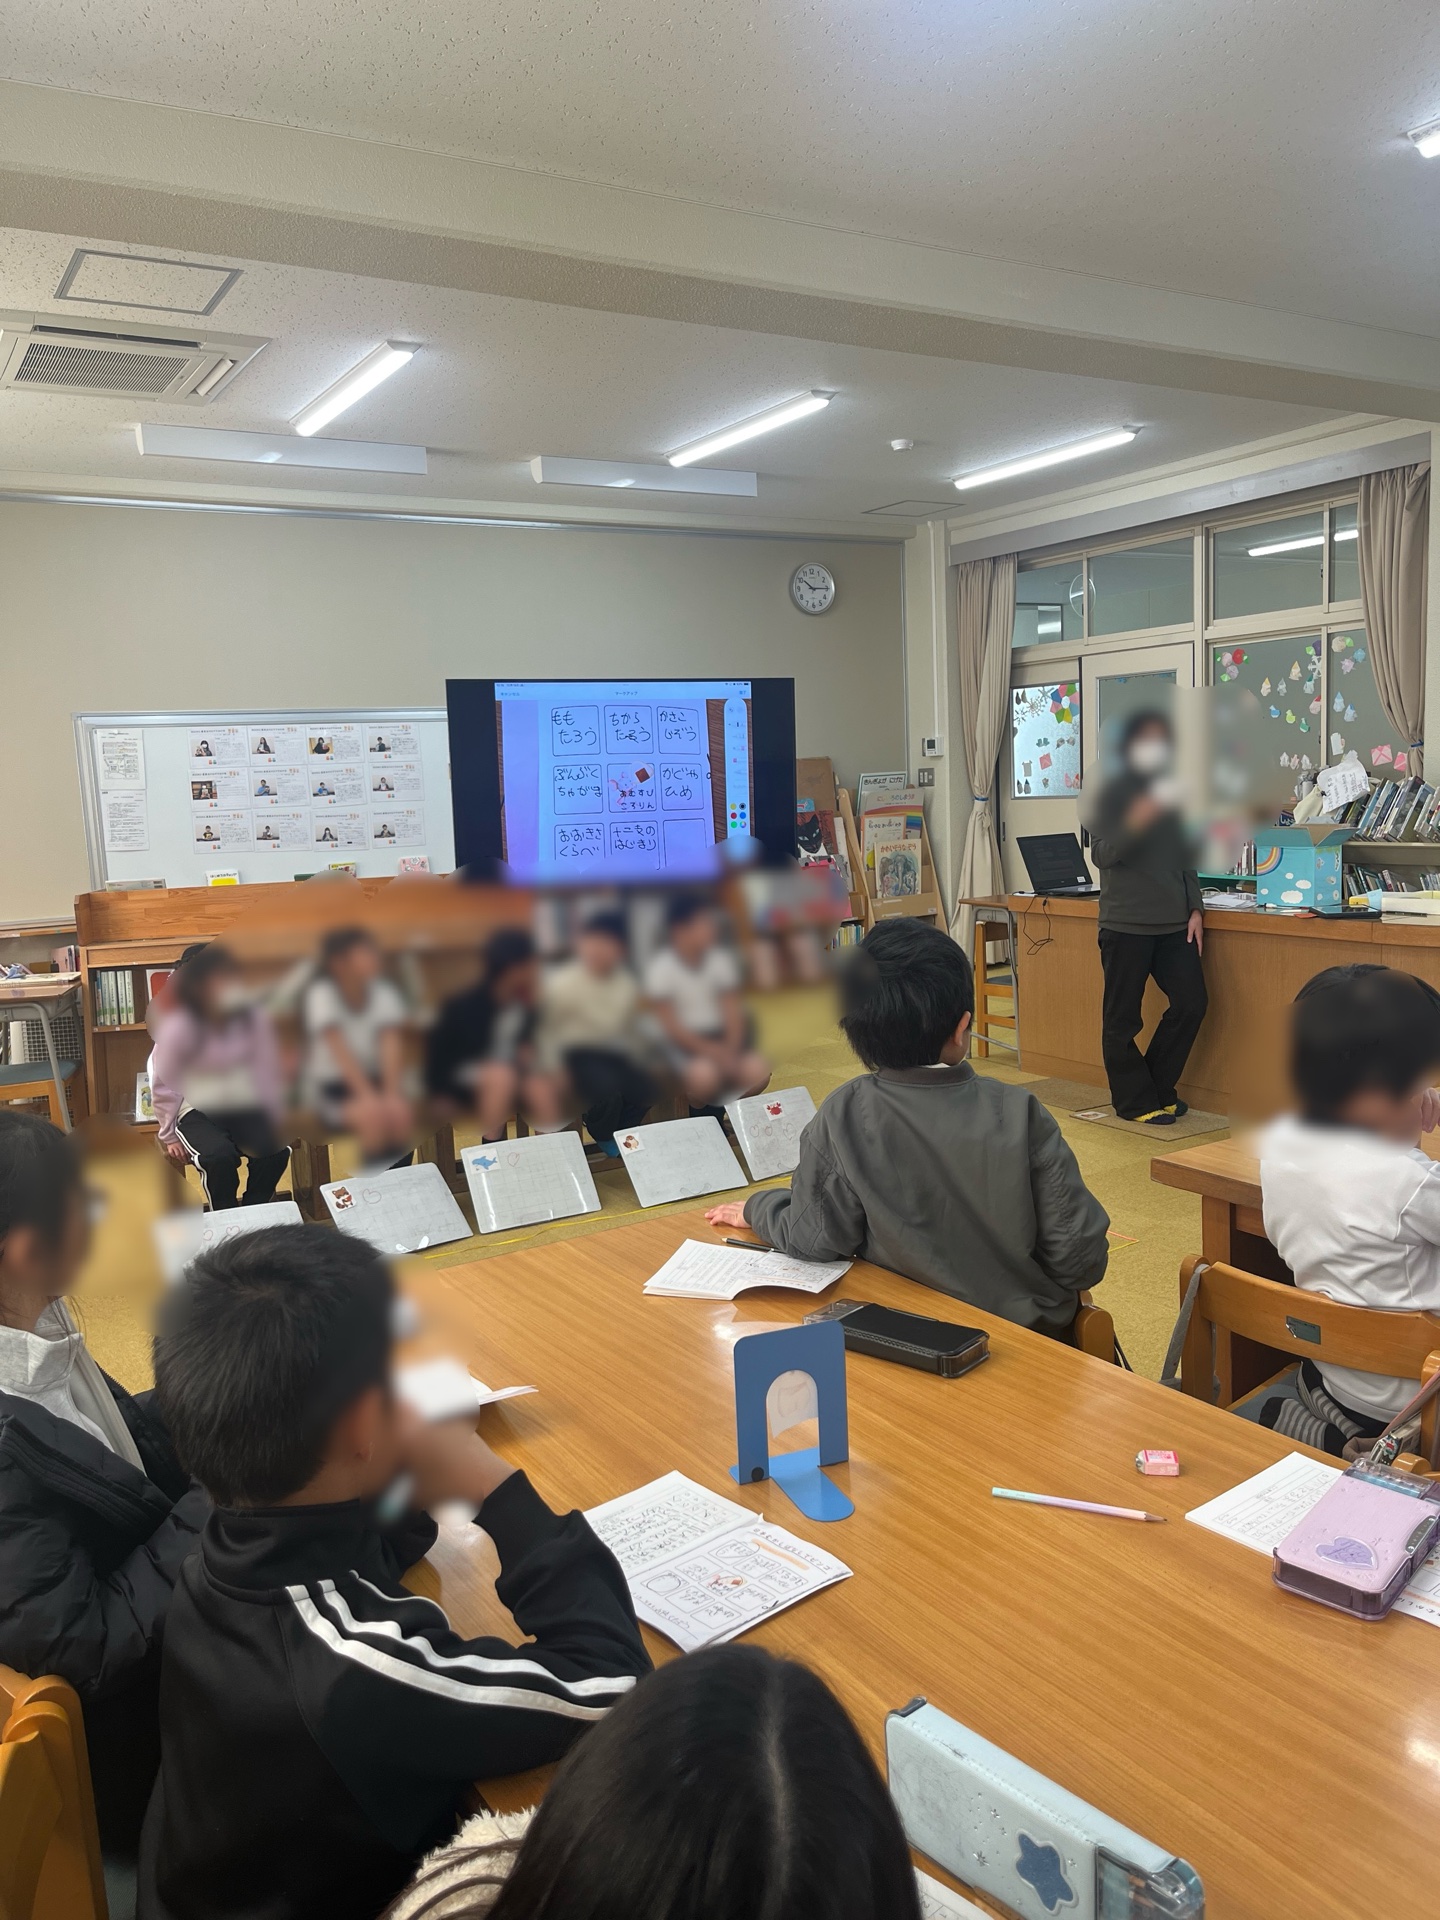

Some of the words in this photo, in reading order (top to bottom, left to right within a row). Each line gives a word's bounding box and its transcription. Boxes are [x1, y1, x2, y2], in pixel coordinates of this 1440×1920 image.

[551, 711, 576, 726] もも
[609, 711, 640, 725] ちから
[659, 711, 686, 723] かさこ
[558, 727, 597, 746] たろう
[664, 727, 697, 742] じぞう
[554, 768, 600, 782] ぶんぶく
[662, 768, 699, 781] かぐや
[557, 786, 603, 798] ちゃがま
[664, 786, 693, 801] ひめ
[620, 801, 655, 811] ころりん
[558, 827, 603, 843] おおきさ
[613, 825, 656, 837] 十二支の
[559, 843, 601, 858] くらべ
[614, 839, 657, 851] はじまり
